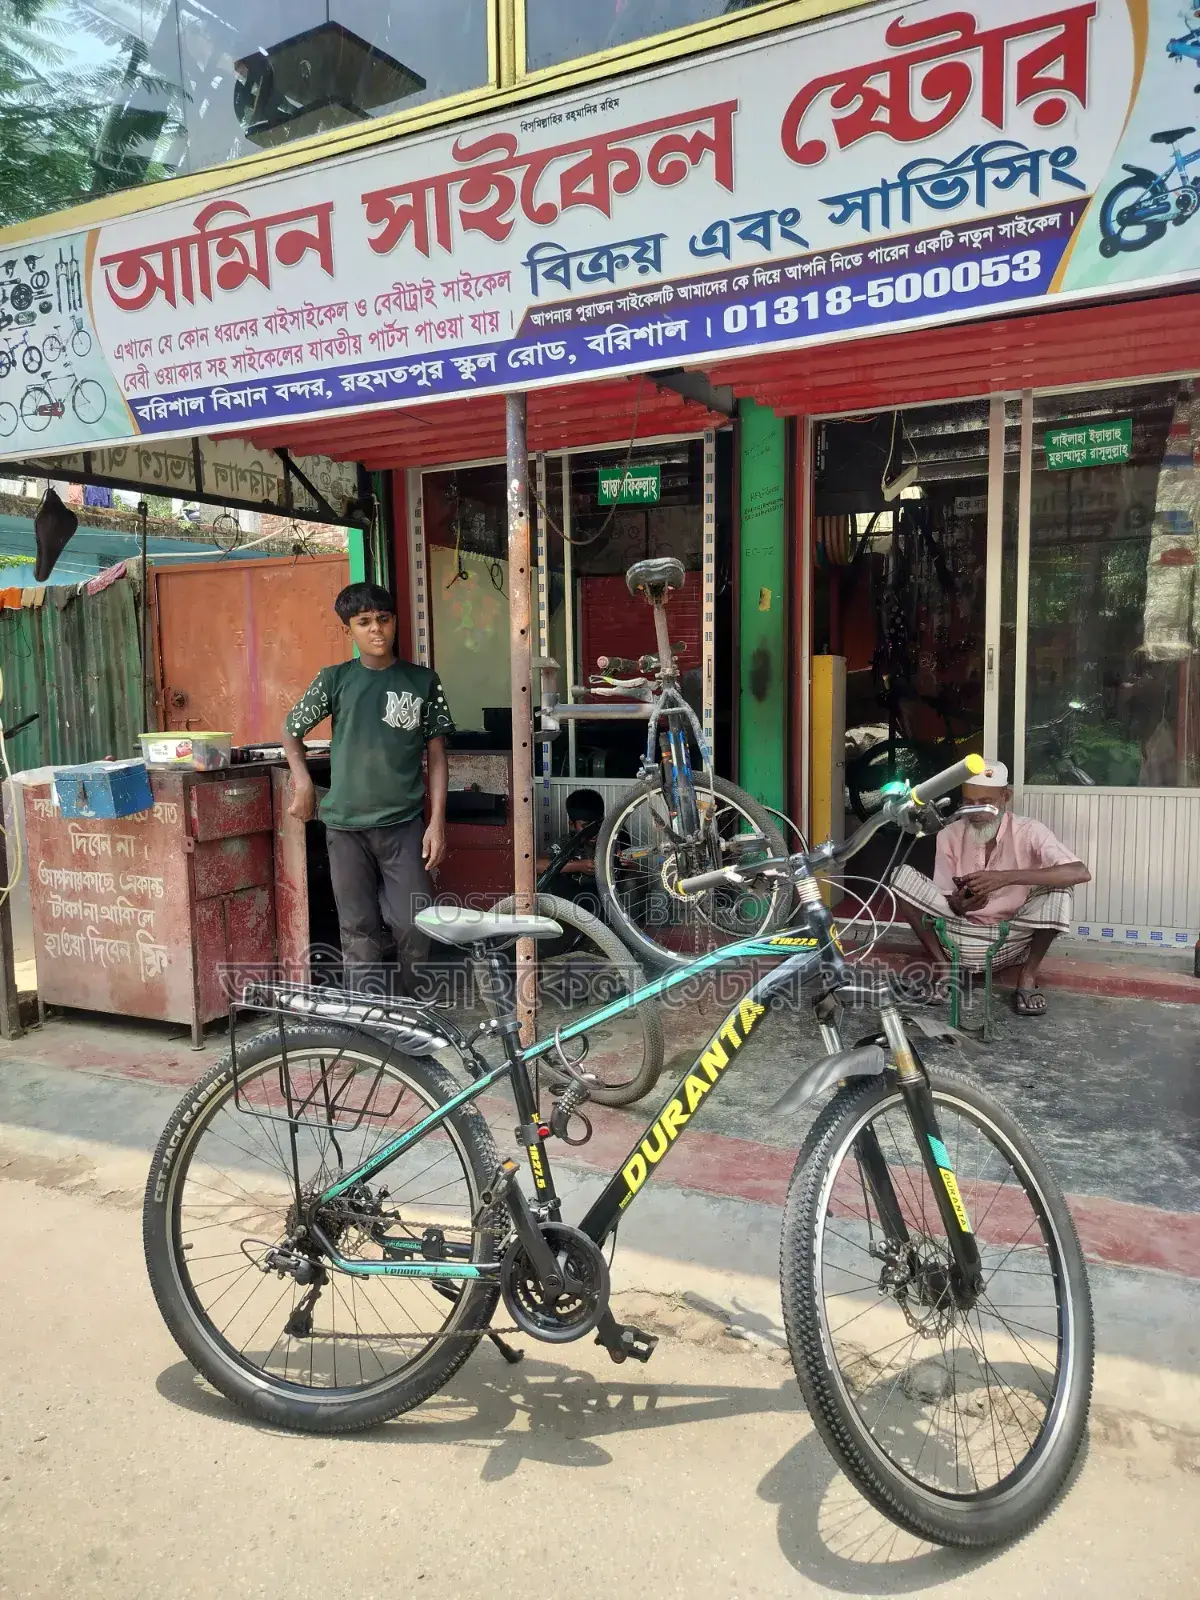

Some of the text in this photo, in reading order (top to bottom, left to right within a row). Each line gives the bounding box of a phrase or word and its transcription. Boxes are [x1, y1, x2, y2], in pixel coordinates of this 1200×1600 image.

[600, 97, 620, 111] রহিম
[100, 1, 1097, 312] আমিন সাইকেল স্টোর
[520, 139, 1087, 297] বিক্রয় এবং সার্ভিসিং
[114, 338, 153, 362] এখানে
[158, 334, 173, 355] যে
[178, 326, 209, 350] কোন
[214, 318, 259, 343] ধরনের
[262, 299, 349, 336] বাইসাইকেল
[355, 299, 367, 318] ও
[440, 270, 512, 303] সাইকেল
[530, 306, 573, 327] আপনার
[575, 300, 614, 322] পুরাতন
[616, 285, 675, 313] সাইকেলটি
[677, 279, 728, 300] আমাদের
[732, 273, 750, 292] কে
[752, 267, 781, 287] দিয়ে
[785, 257, 827, 281] আপনি
[830, 252, 863, 274] নিতে
[867, 243, 910, 266] পারেন
[914, 231, 956, 256] একটি
[958, 225, 994, 250] নতুন
[998, 213, 1063, 240] সাইকেল
[123, 362, 150, 393] বেবী
[154, 360, 203, 386] ওয়াকার
[205, 357, 229, 379] সহ
[230, 343, 303, 373] সাইকেলের
[307, 327, 363, 362] যাবতীয়
[368, 318, 410, 353] পার্টস
[415, 313, 464, 345] পাওয়া
[468, 308, 500, 336] যায়
[135, 394, 205, 422] বরিশাল
[210, 386, 268, 413] বিমান
[272, 377, 334, 400] বন্দর,
[338, 360, 445, 393] রহমতপুর
[449, 351, 498, 383] স্কুল
[507, 339, 577, 369] রোড,
[584, 318, 690, 356] বরিশাল
[723, 250, 1042, 334] 01318-500053
[1052, 431, 1087, 448] লাইলাহা
[68, 822, 112, 857] দিবেন
[115, 834, 136, 858] না
[162, 1123, 187, 1169] JACK
[182, 1071, 228, 1125] RABBIT
[622, 998, 765, 1194] DURANTA
[943, 1172, 967, 1226] DURANTA
